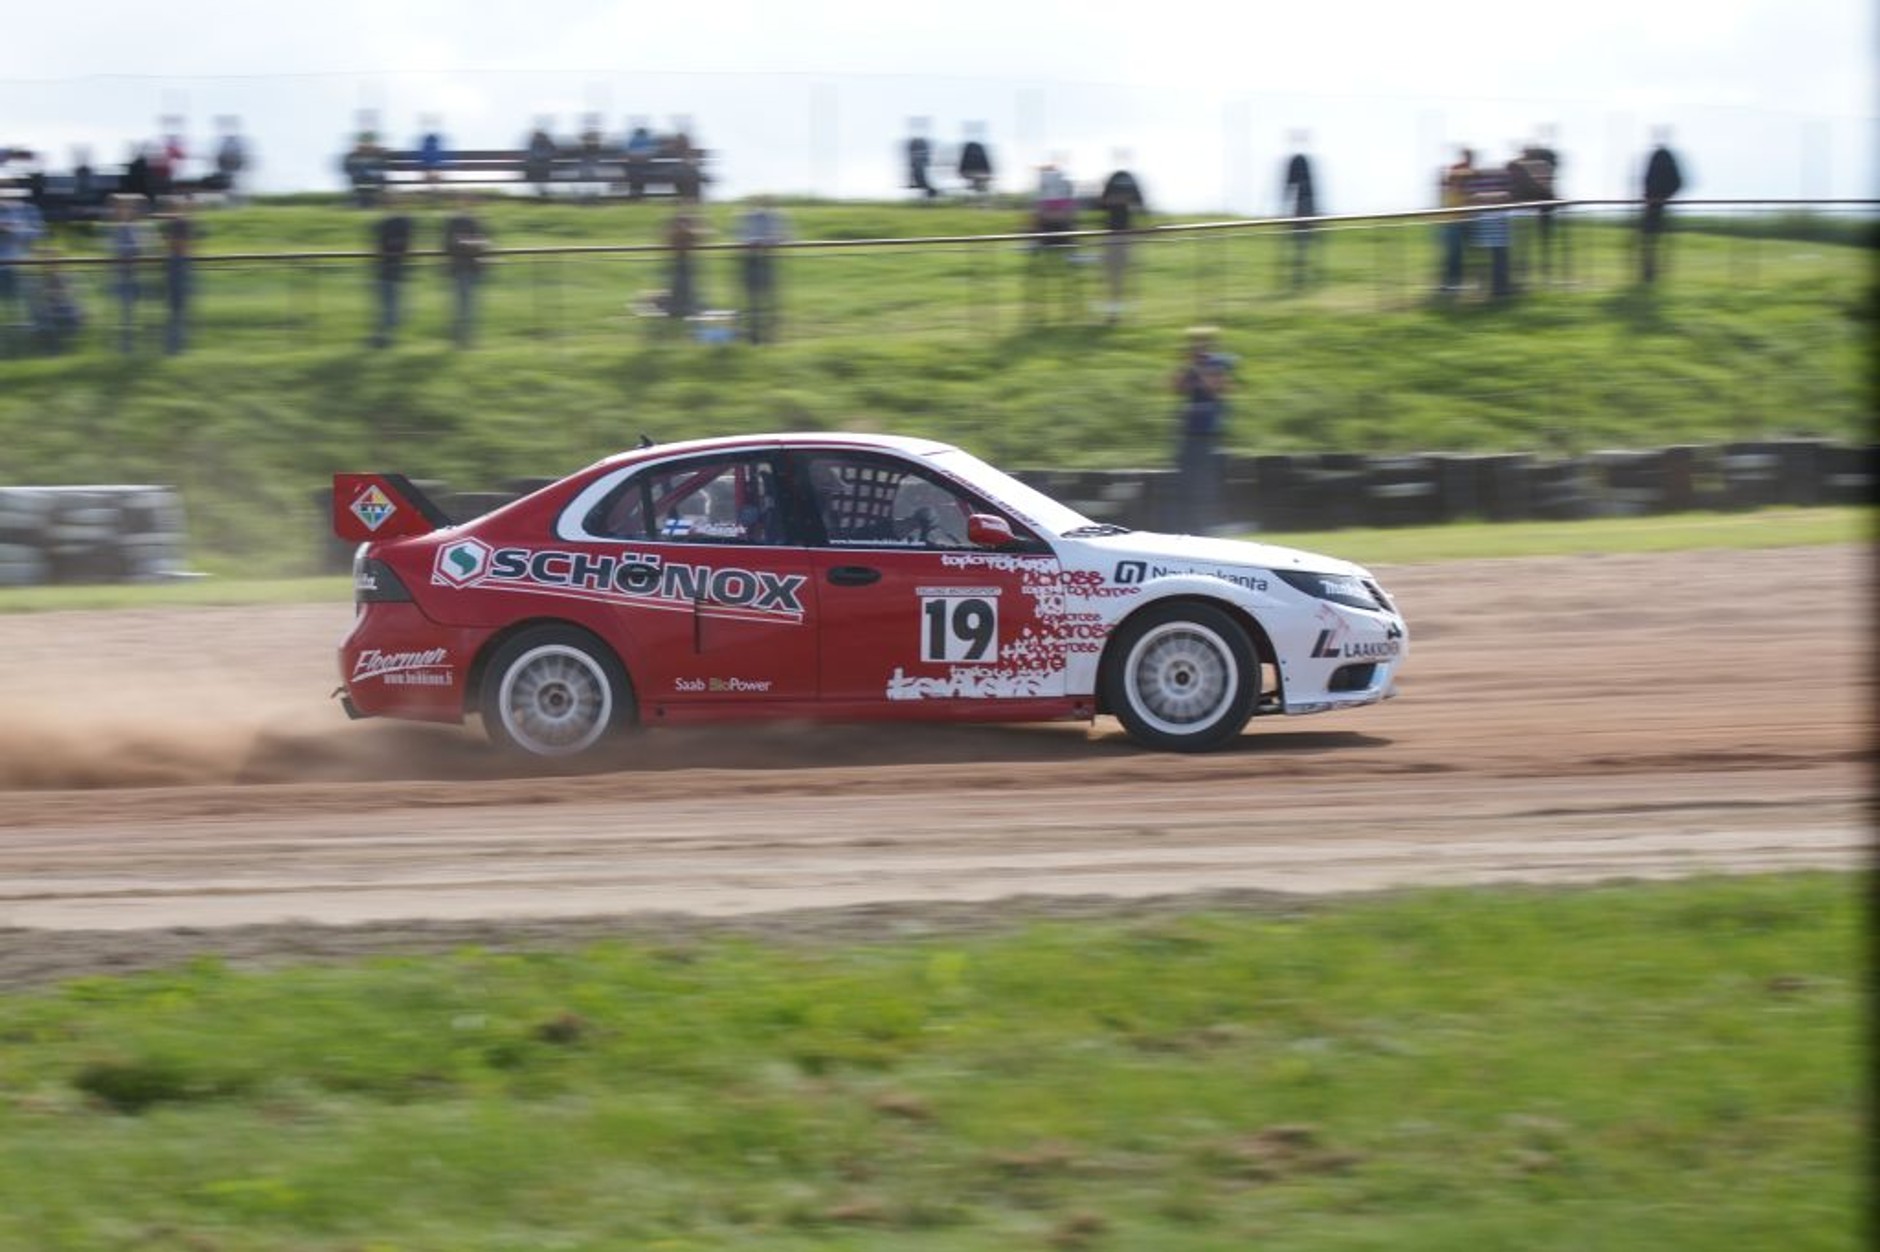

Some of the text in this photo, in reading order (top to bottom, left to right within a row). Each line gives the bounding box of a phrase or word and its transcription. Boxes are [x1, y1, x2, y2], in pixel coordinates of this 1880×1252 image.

[491, 548, 807, 613] SCHÖNOX
[925, 598, 995, 660] 19
[674, 677, 772, 692] Saab BioPower
